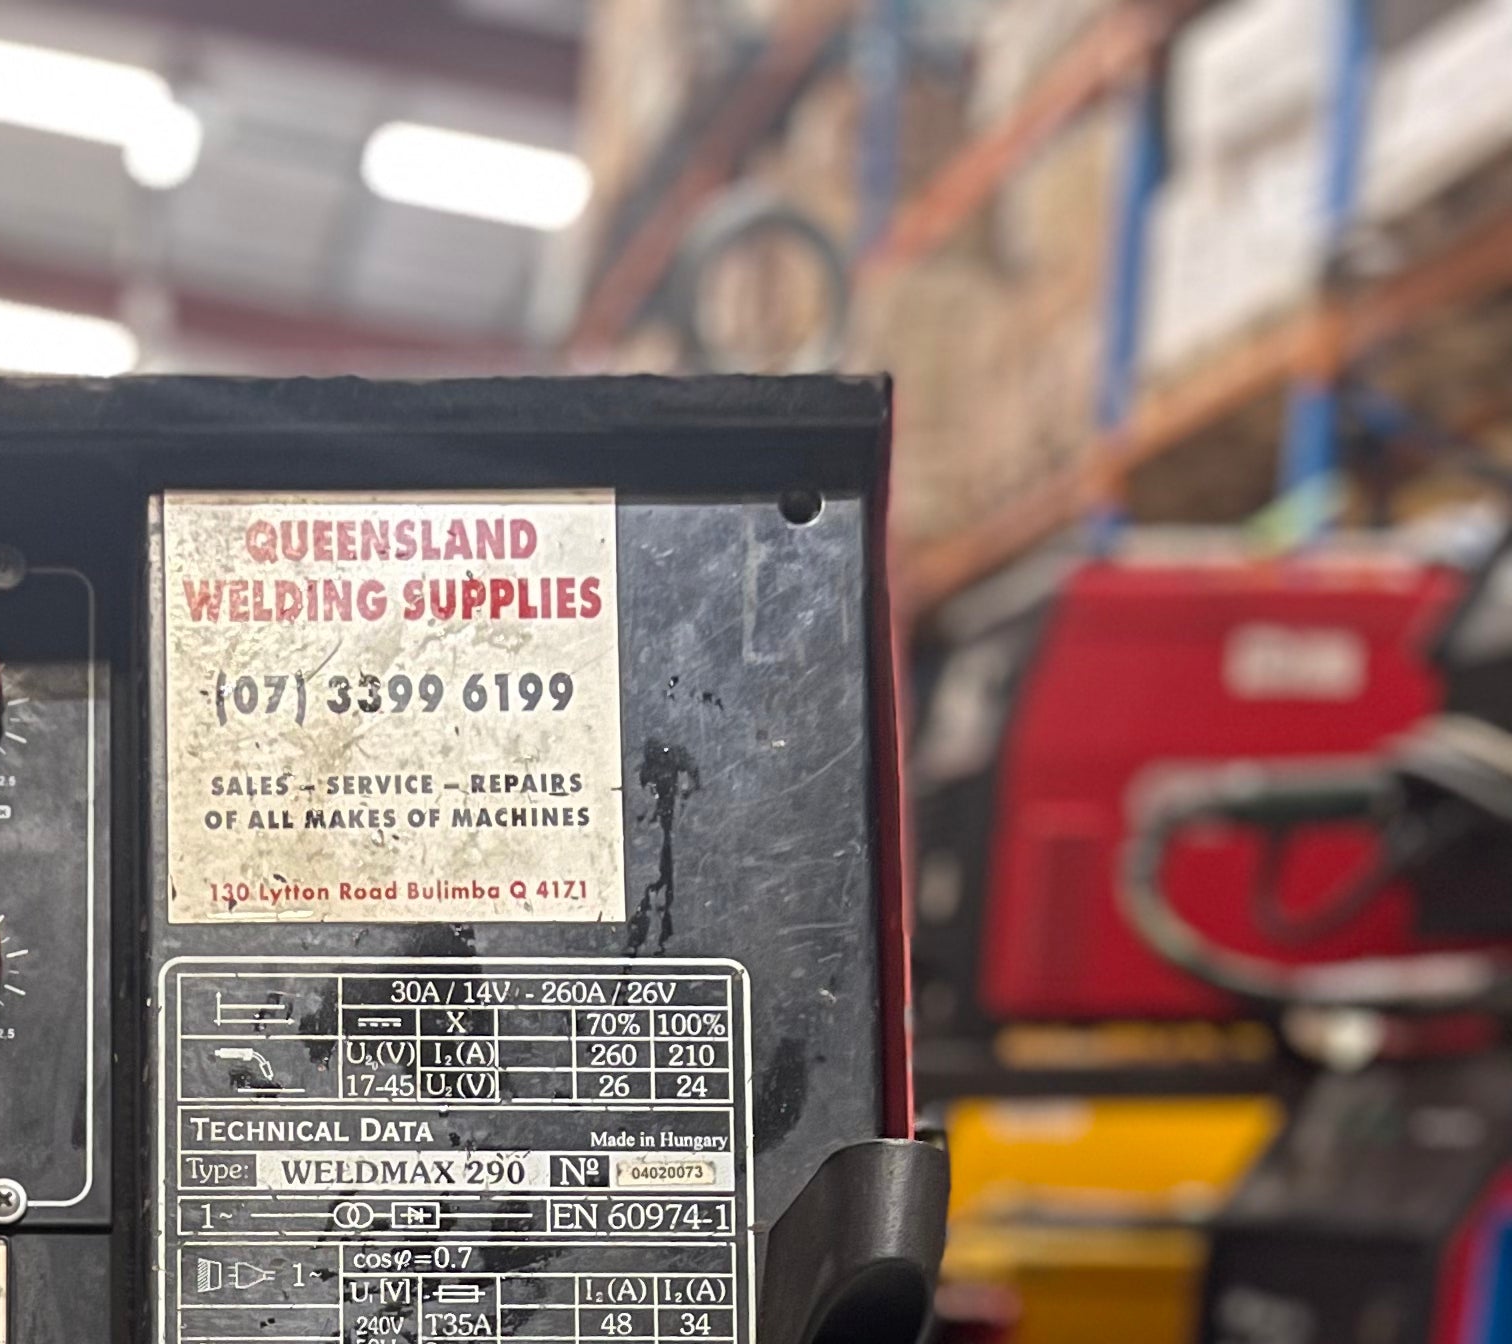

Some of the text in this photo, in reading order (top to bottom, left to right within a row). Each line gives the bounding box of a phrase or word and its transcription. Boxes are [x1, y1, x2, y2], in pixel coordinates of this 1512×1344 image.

[245, 519, 538, 563] QUEENSLAND
[183, 576, 602, 622] WELDING SUPPLIES
[215, 670, 574, 727] (07) 3399 6199
[211, 775, 289, 796] SALES
[326, 775, 433, 795] SERVICE
[470, 774, 583, 795] REPAIRS
[204, 808, 590, 829] OF ALL MAKES OF MACHINES
[210, 880, 588, 906] 130 Lytton Road Bulimba Q 4171
[391, 981, 440, 1003] 30A
[464, 981, 510, 1004] 14V
[542, 981, 606, 1004] 260A
[628, 982, 677, 1004] 26V
[447, 1012, 466, 1033] X
[587, 1013, 640, 1035] 70%
[658, 1012, 726, 1036] 100%
[591, 1043, 637, 1066] 260
[669, 1043, 714, 1067] 210
[346, 1074, 415, 1097] 17-45
[599, 1074, 630, 1097] 26
[676, 1074, 707, 1098] 24
[190, 1118, 434, 1143] TECHNICAL DATA
[590, 1132, 728, 1152] Made in Hungary
[187, 1158, 526, 1185] Type: WELDMAX 290
[631, 1165, 704, 1180] 04020073
[553, 1202, 730, 1230] EN 60974-1
[356, 1316, 404, 1335] 240V
[425, 1313, 492, 1337] T35A
[601, 1313, 633, 1335] 48
[680, 1313, 711, 1336] 34
